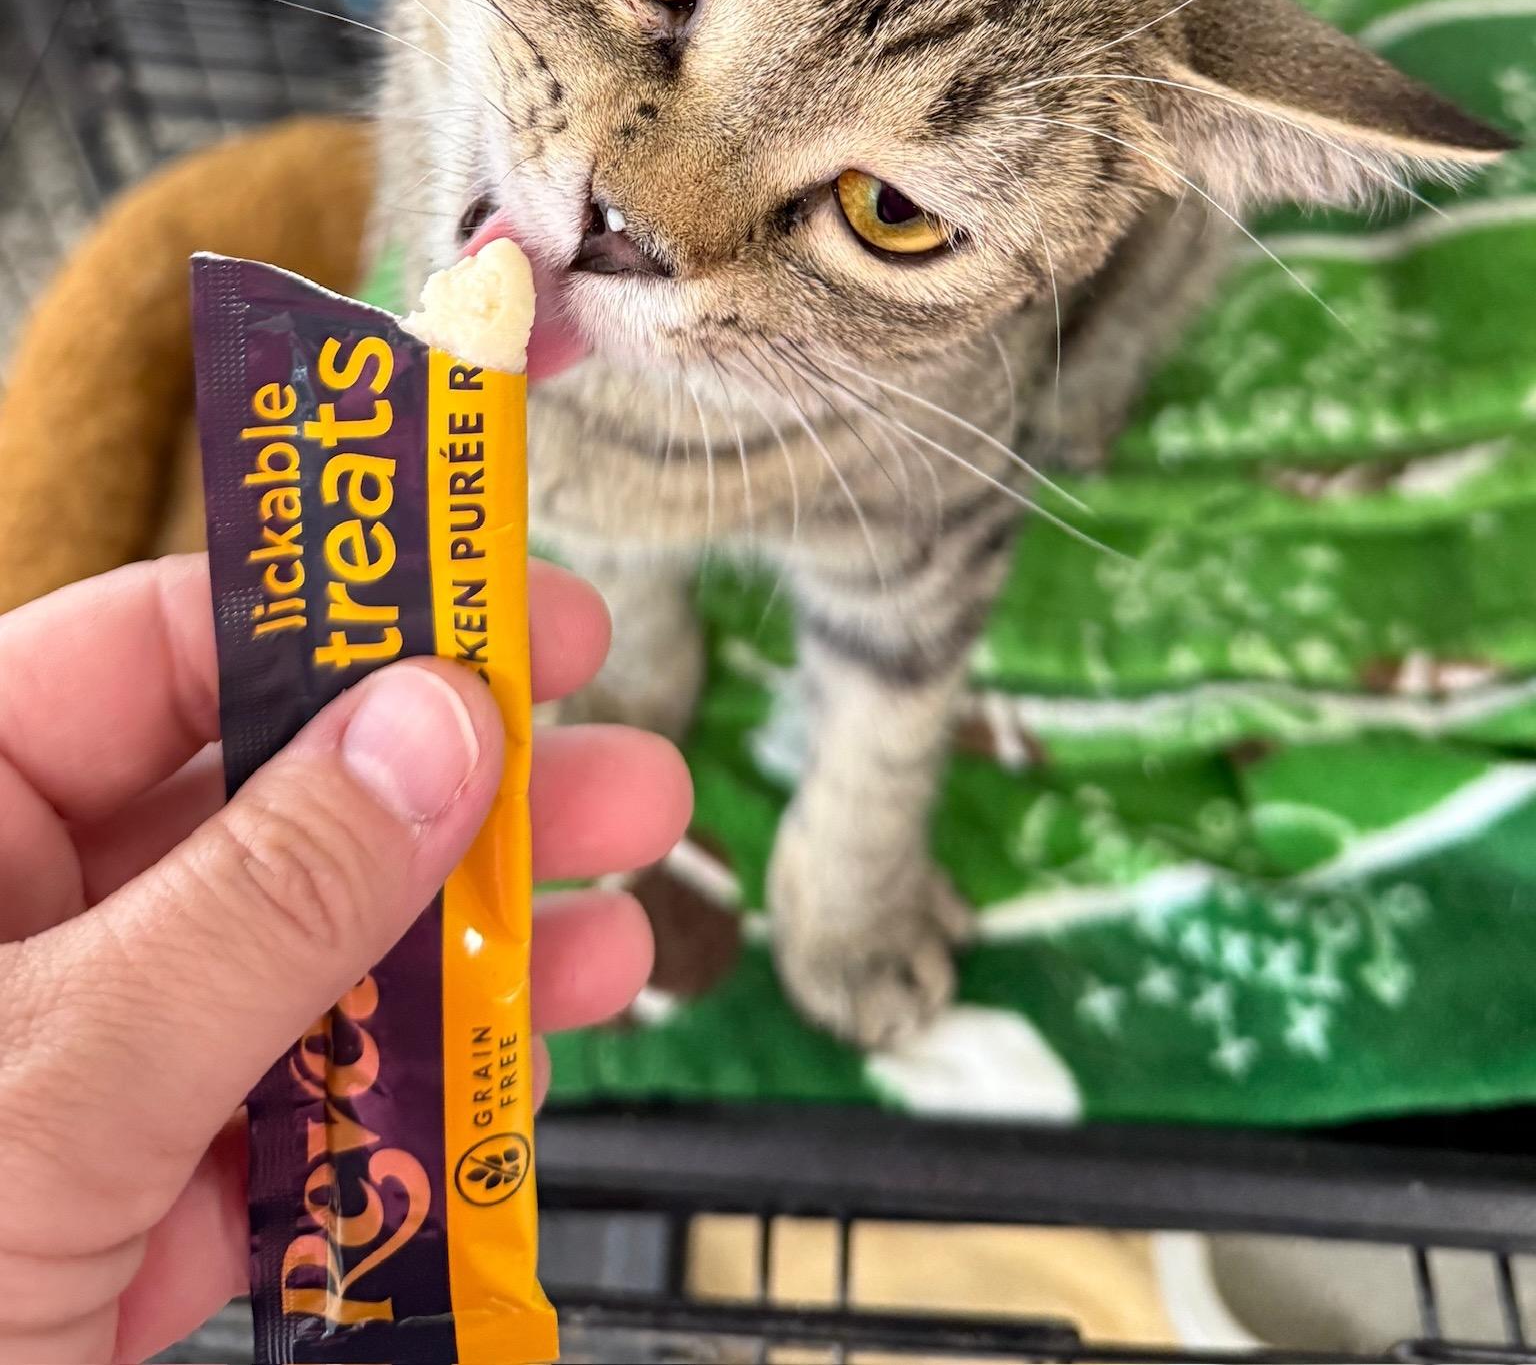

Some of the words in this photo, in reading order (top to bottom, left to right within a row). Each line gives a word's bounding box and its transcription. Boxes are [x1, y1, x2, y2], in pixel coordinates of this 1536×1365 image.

[241, 381, 307, 639] lickable
[303, 335, 404, 669] treats
[438, 412, 486, 561] PURÉE
[452, 578, 490, 686] KEN
[472, 1026, 493, 1128] GRAIN
[500, 1032, 518, 1109] FREE
[282, 972, 432, 1325] Reve
